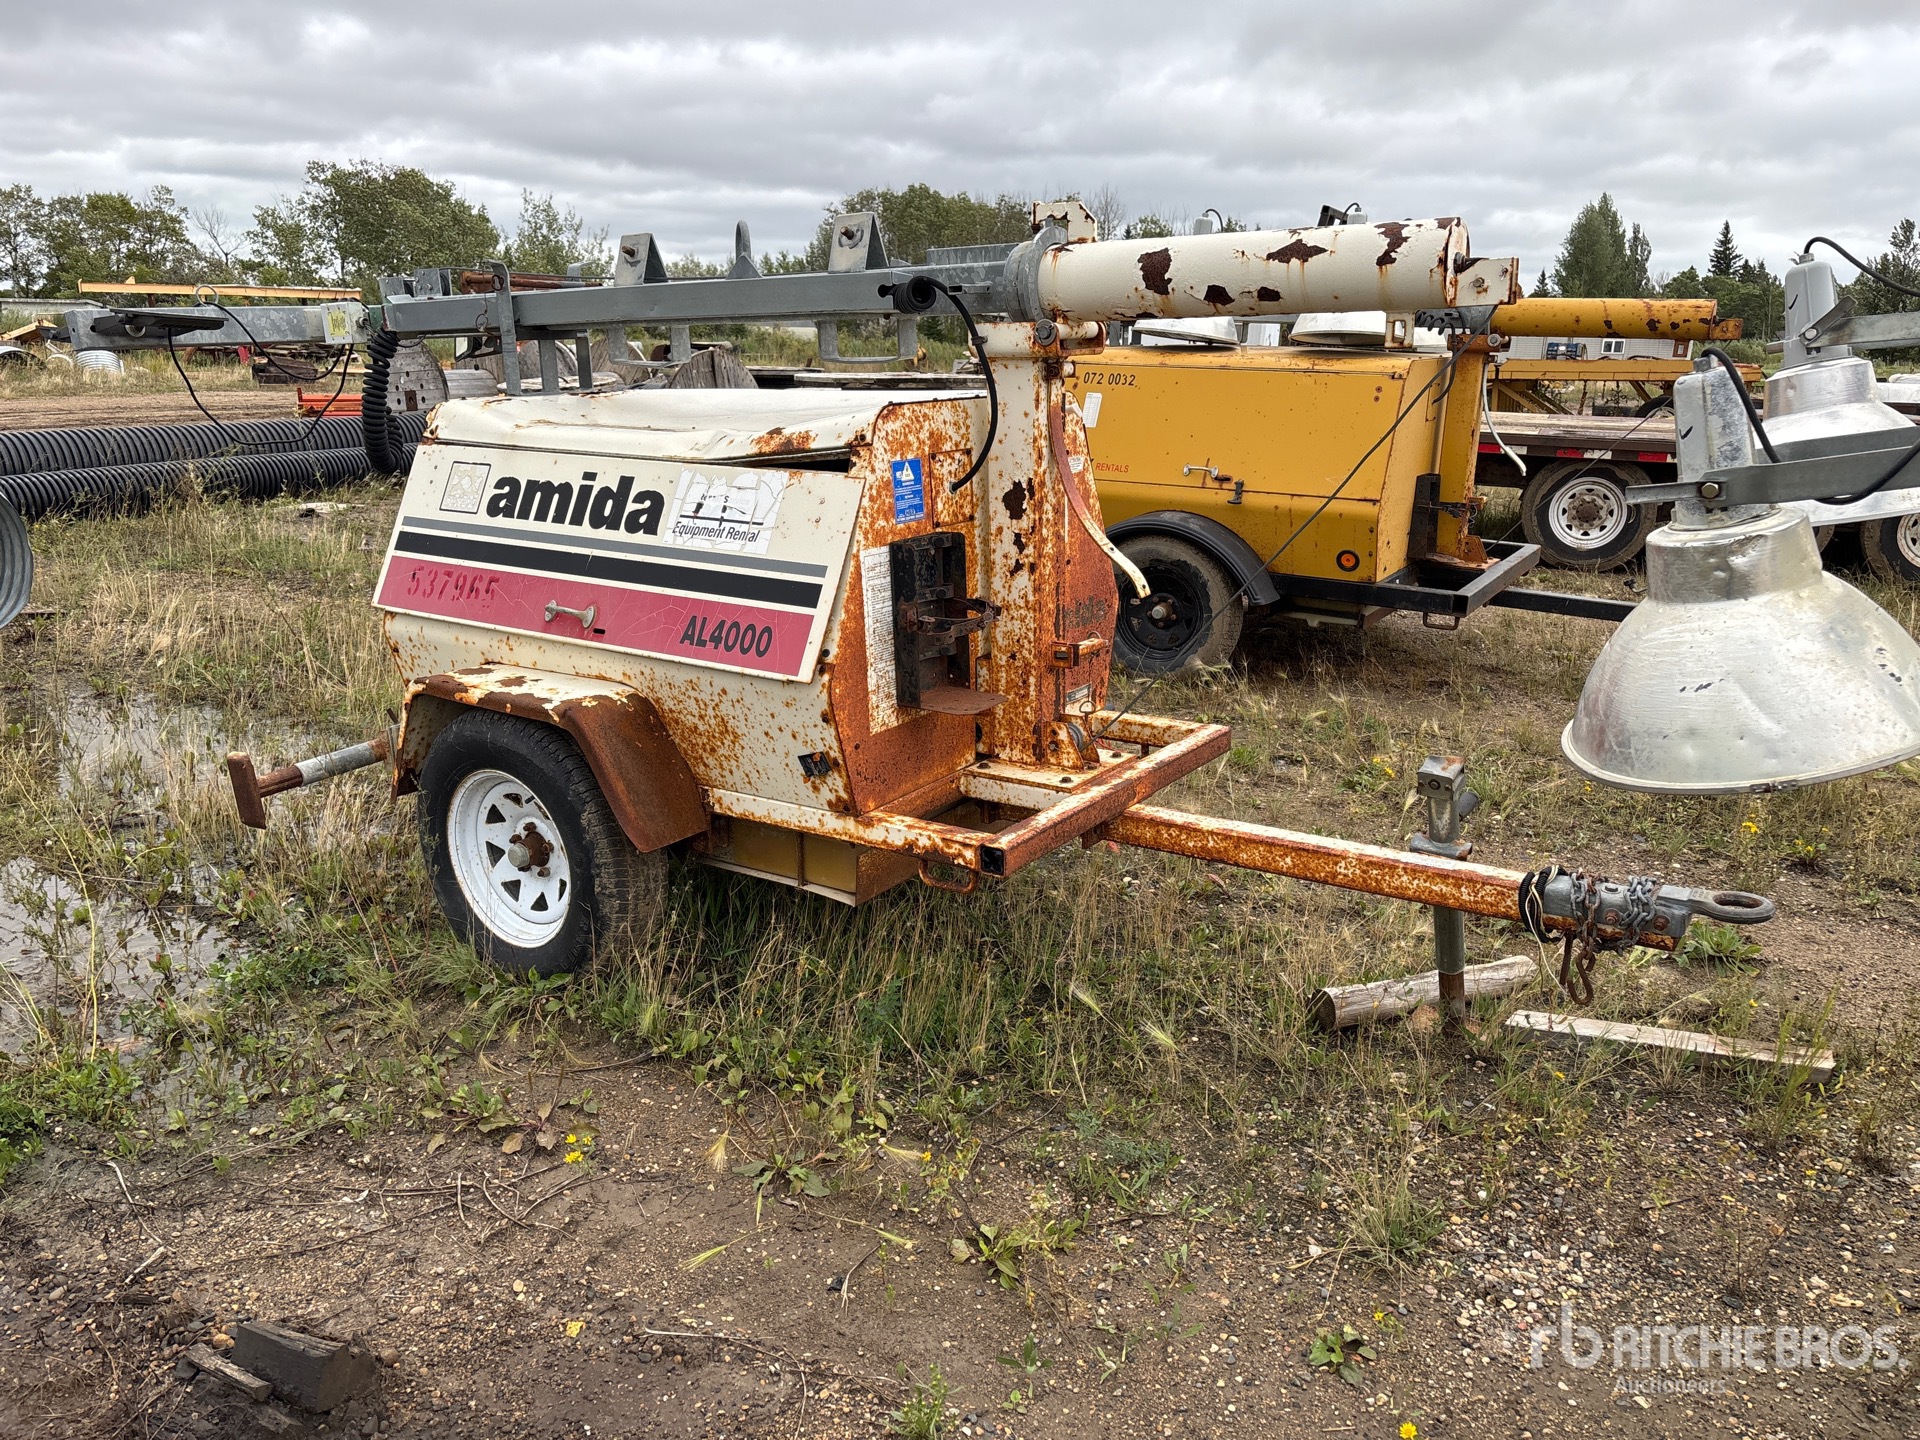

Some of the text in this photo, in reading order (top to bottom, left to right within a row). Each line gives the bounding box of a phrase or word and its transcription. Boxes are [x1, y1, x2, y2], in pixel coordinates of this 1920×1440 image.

[1083, 372, 1136, 386] 072 0032
[1095, 462, 1129, 473] RENTALS
[486, 471, 665, 536] amida
[672, 521, 726, 539] Equipment
[407, 565, 500, 608] 537965
[679, 615, 773, 658] AL4000
